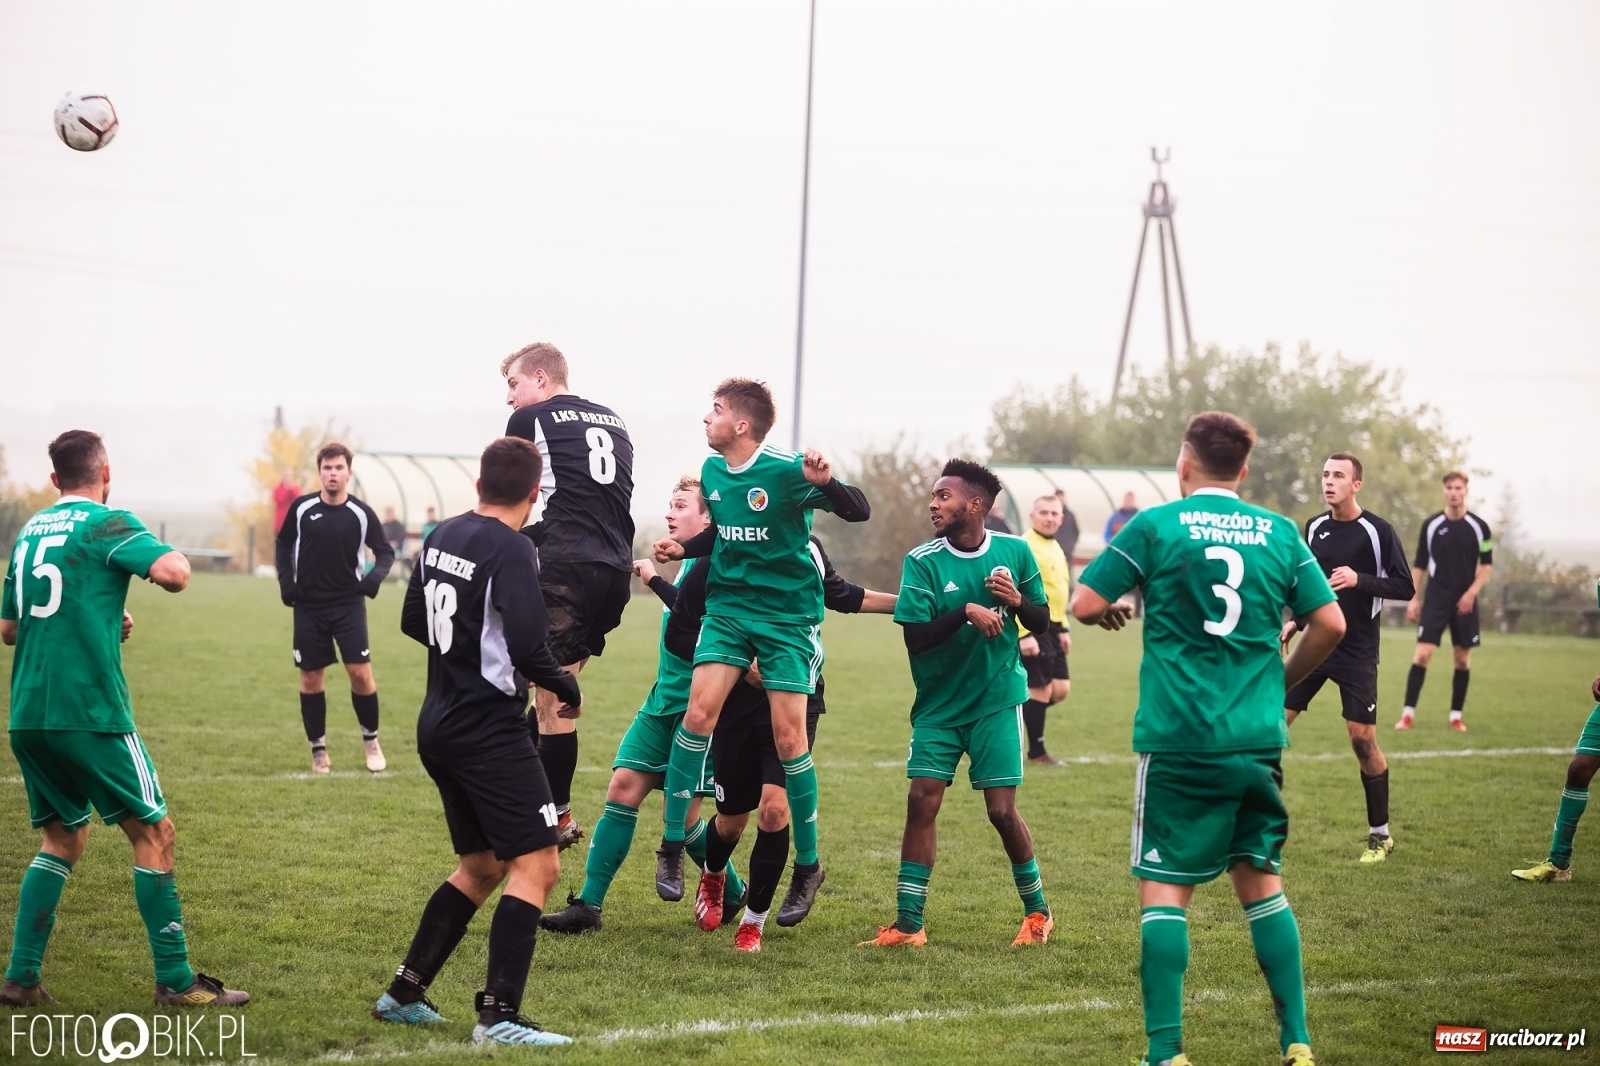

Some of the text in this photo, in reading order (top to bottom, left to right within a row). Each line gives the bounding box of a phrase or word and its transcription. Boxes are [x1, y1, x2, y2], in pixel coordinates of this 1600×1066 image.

[551, 410, 579, 424] LKS
[585, 427, 616, 485] 8
[24, 509, 90, 528] APRZÓD 32
[1179, 510, 1273, 534] NAPRZÓD 32
[1188, 525, 1267, 546] SYRYNIA
[14, 534, 69, 619] 15
[1203, 545, 1245, 637] 3
[423, 578, 458, 655] 18
[715, 781, 725, 802] 9
